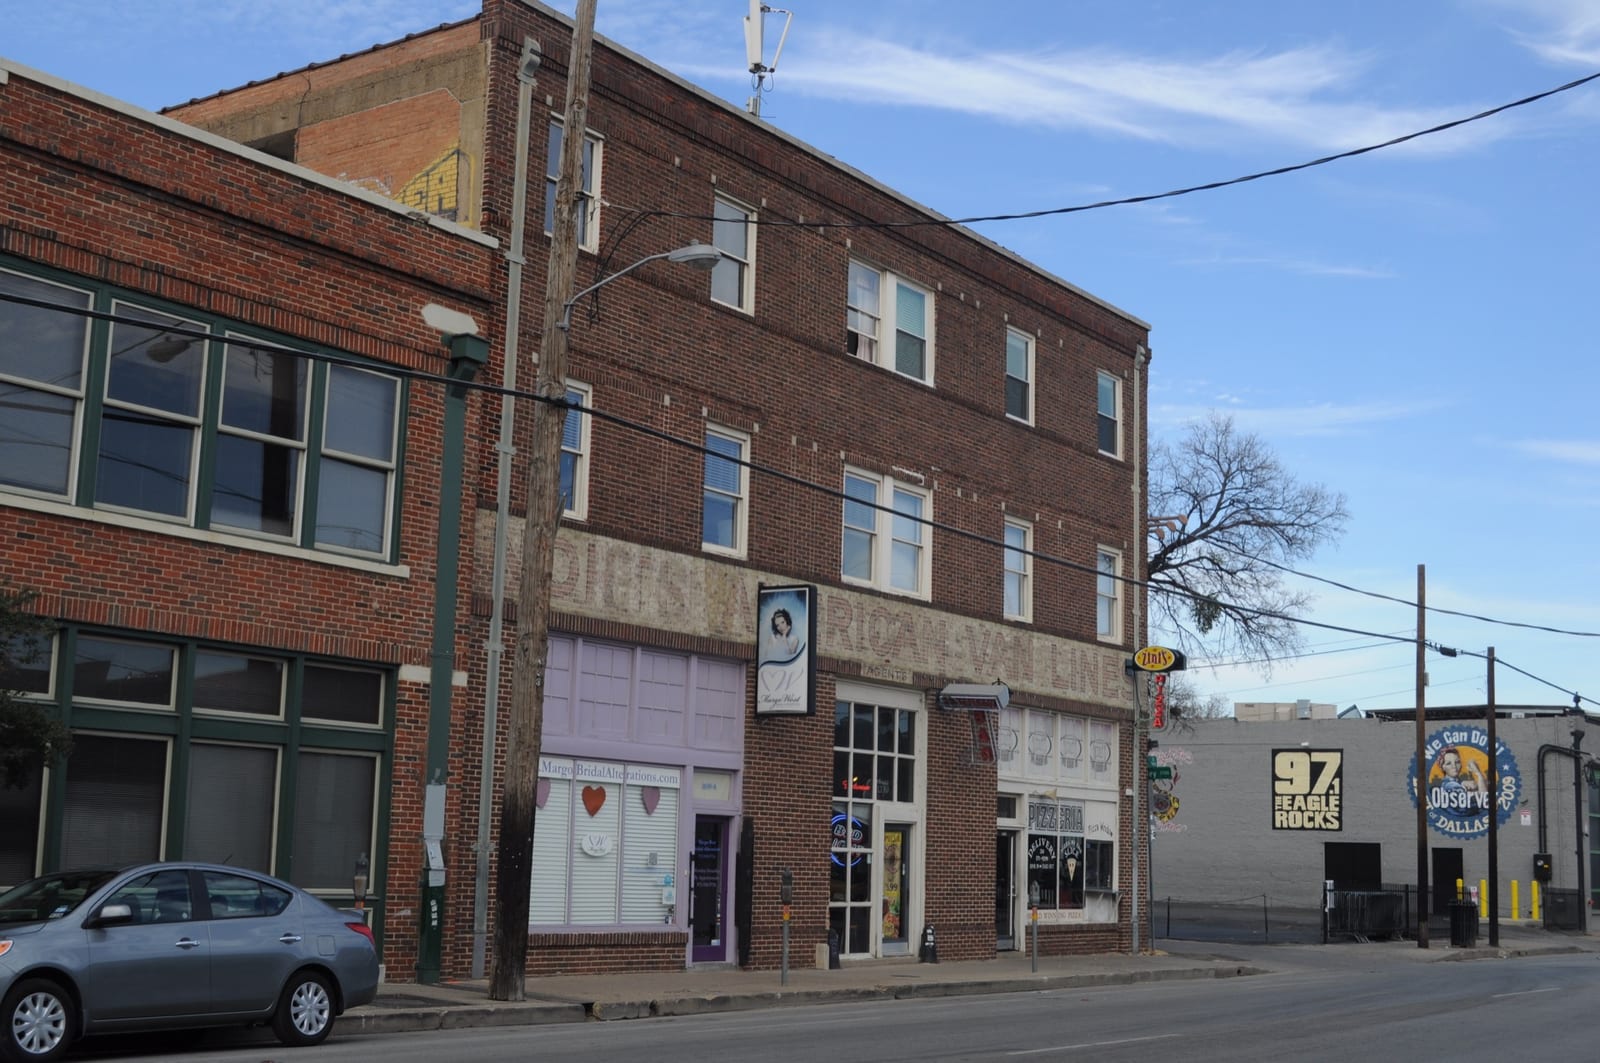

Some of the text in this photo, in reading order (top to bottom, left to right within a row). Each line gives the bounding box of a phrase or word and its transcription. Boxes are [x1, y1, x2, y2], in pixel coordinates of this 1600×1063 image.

[866, 665, 908, 681] AGENTS
[1425, 730, 1488, 760] We Can Do
[1274, 751, 1341, 795] 97.1
[1282, 795, 1340, 811] EAGLE
[1432, 787, 1498, 809] Observe
[1436, 815, 1489, 833] DALLAS
[1498, 775, 1516, 811] 2009
[1274, 810, 1340, 830] ROCKS
[1028, 837, 1057, 860] DELIVERY
